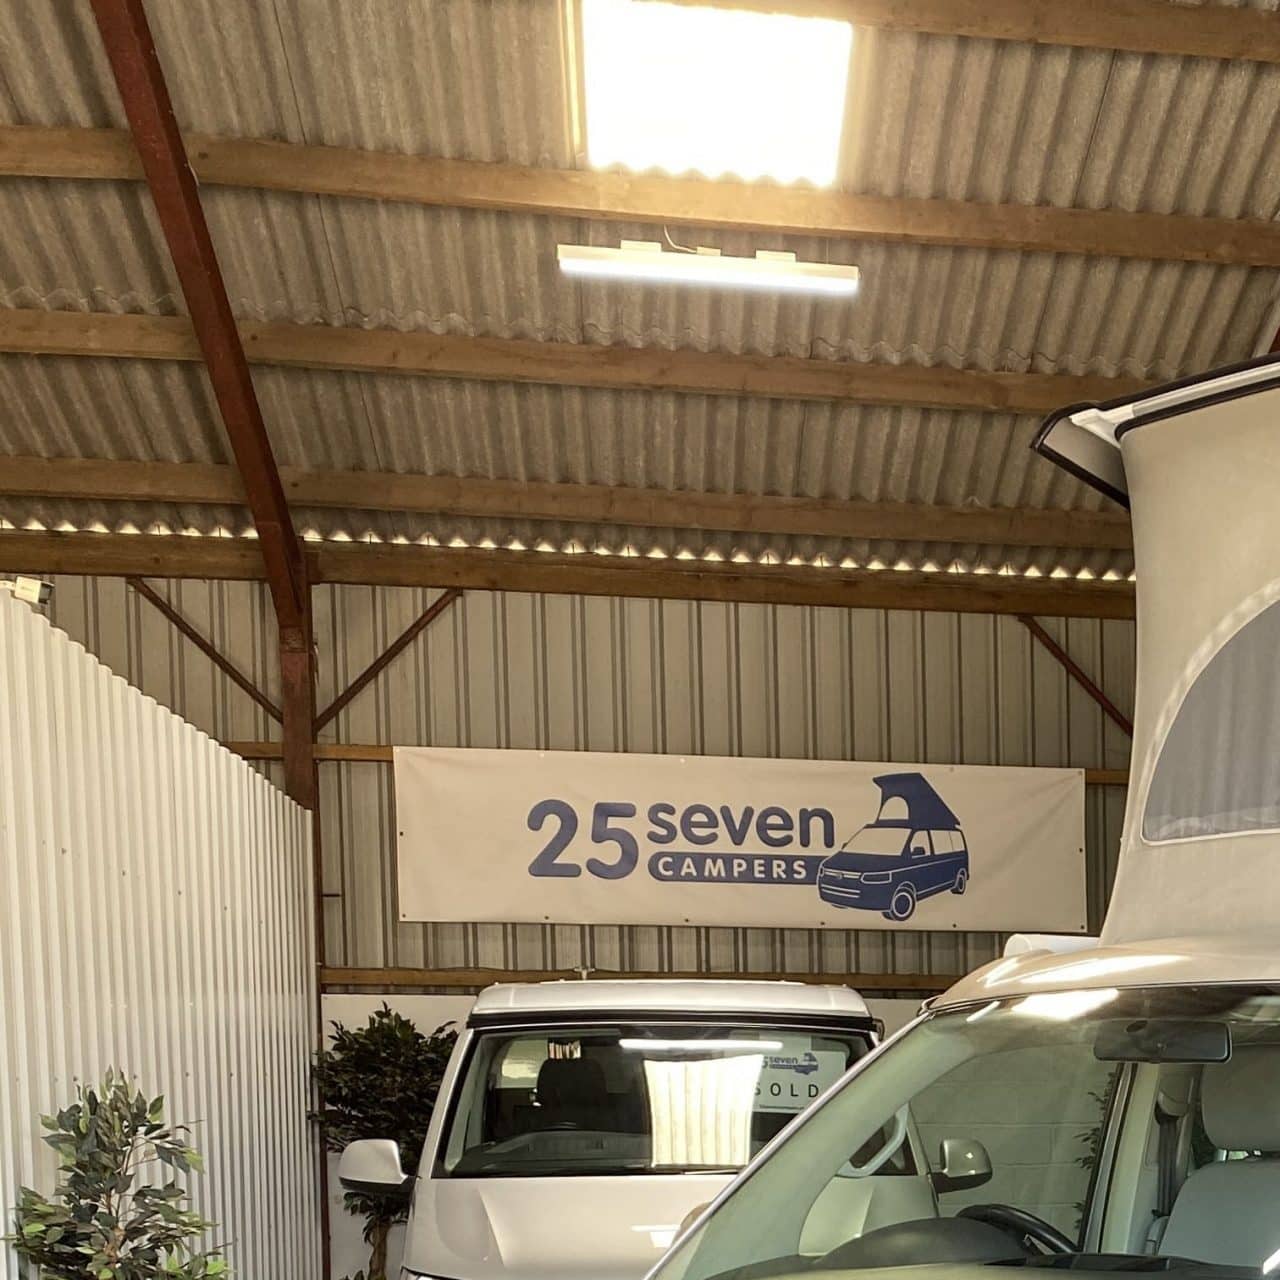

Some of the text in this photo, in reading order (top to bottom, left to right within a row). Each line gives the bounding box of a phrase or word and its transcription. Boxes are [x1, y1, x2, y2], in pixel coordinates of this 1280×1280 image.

[527, 799, 836, 880] 25 seven
[657, 856, 808, 879] CAMPERS
